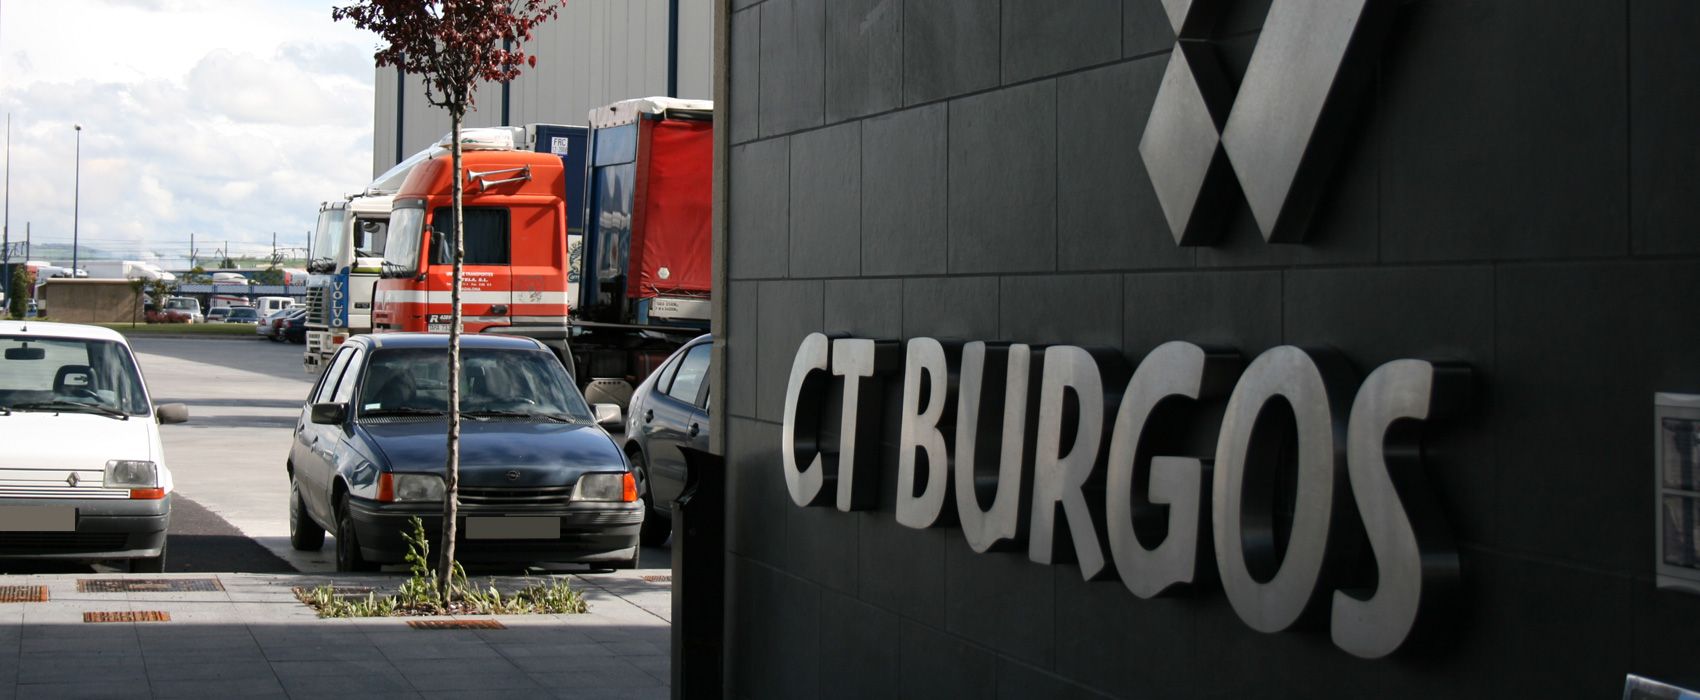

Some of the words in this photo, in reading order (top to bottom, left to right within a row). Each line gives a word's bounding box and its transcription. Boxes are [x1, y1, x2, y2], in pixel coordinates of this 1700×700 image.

[332, 281, 343, 327] VOLVO
[782, 332, 875, 512] CT
[896, 337, 1433, 659] BURGOS
